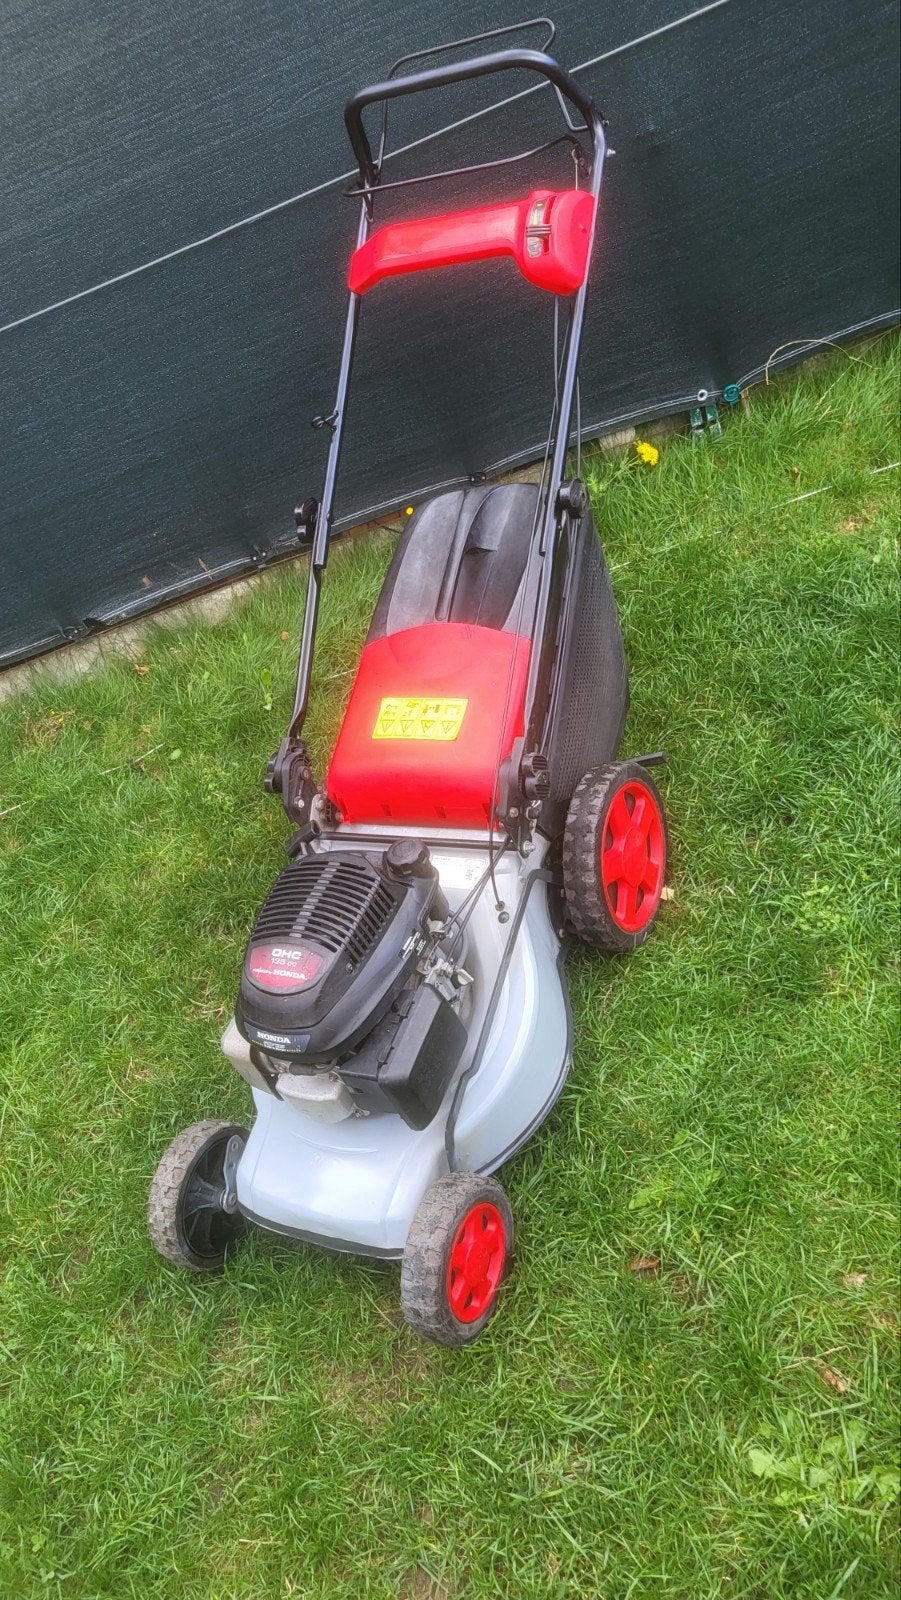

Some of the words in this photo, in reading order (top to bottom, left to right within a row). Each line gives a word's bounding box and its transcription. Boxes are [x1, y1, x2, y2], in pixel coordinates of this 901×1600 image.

[271, 948, 302, 960] OHC
[273, 969, 306, 980] HONDA
[256, 1031, 291, 1044] HONDA
